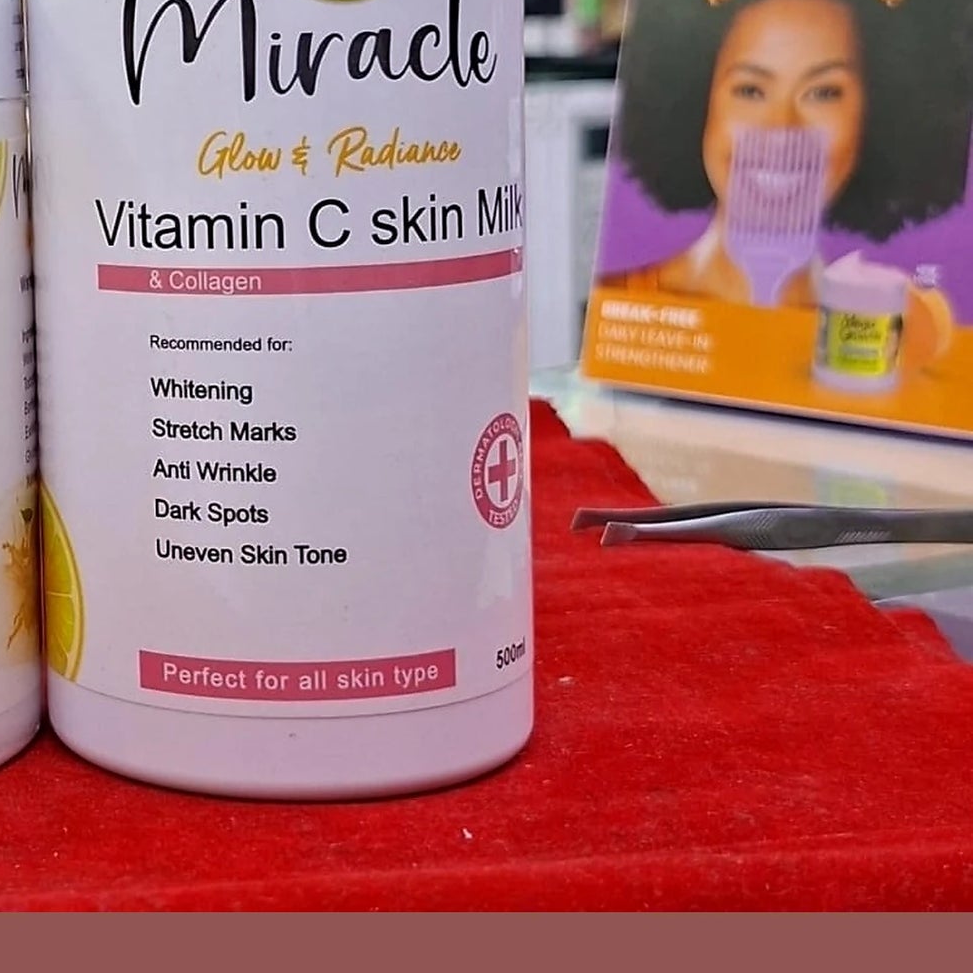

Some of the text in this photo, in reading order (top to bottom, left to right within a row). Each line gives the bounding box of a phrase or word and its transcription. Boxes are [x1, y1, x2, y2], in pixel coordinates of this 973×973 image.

[197, 127, 462, 179] Glow & Radiance
[95, 183, 523, 249] Vitamin C skin Milk
[149, 270, 262, 295] & Collagen
[149, 335, 293, 352] Recommended for:
[150, 378, 253, 404] Whitening
[152, 418, 297, 442] Stretch Marks
[153, 459, 277, 483] Anti Wrinkle
[154, 499, 269, 527] Dark Spots
[156, 539, 348, 565] Uneven Skin Tone
[162, 662, 439, 691] Perfect for all skin type
